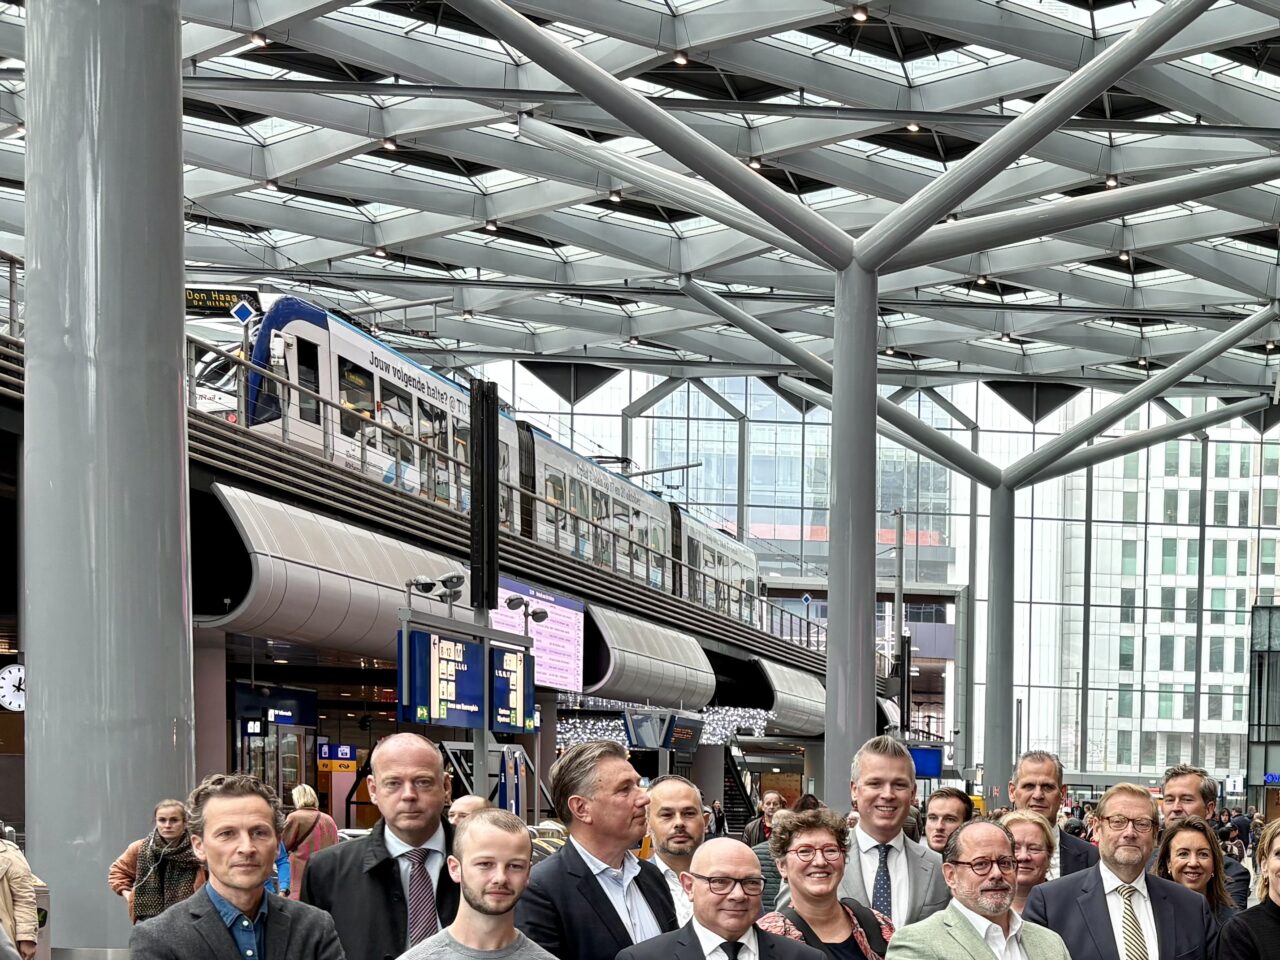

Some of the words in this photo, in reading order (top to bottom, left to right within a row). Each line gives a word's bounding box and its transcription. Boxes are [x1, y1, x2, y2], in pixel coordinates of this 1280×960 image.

[369, 351, 391, 374] Jouw
[392, 366, 425, 393] volgende
[426, 381, 448, 406] halte?
